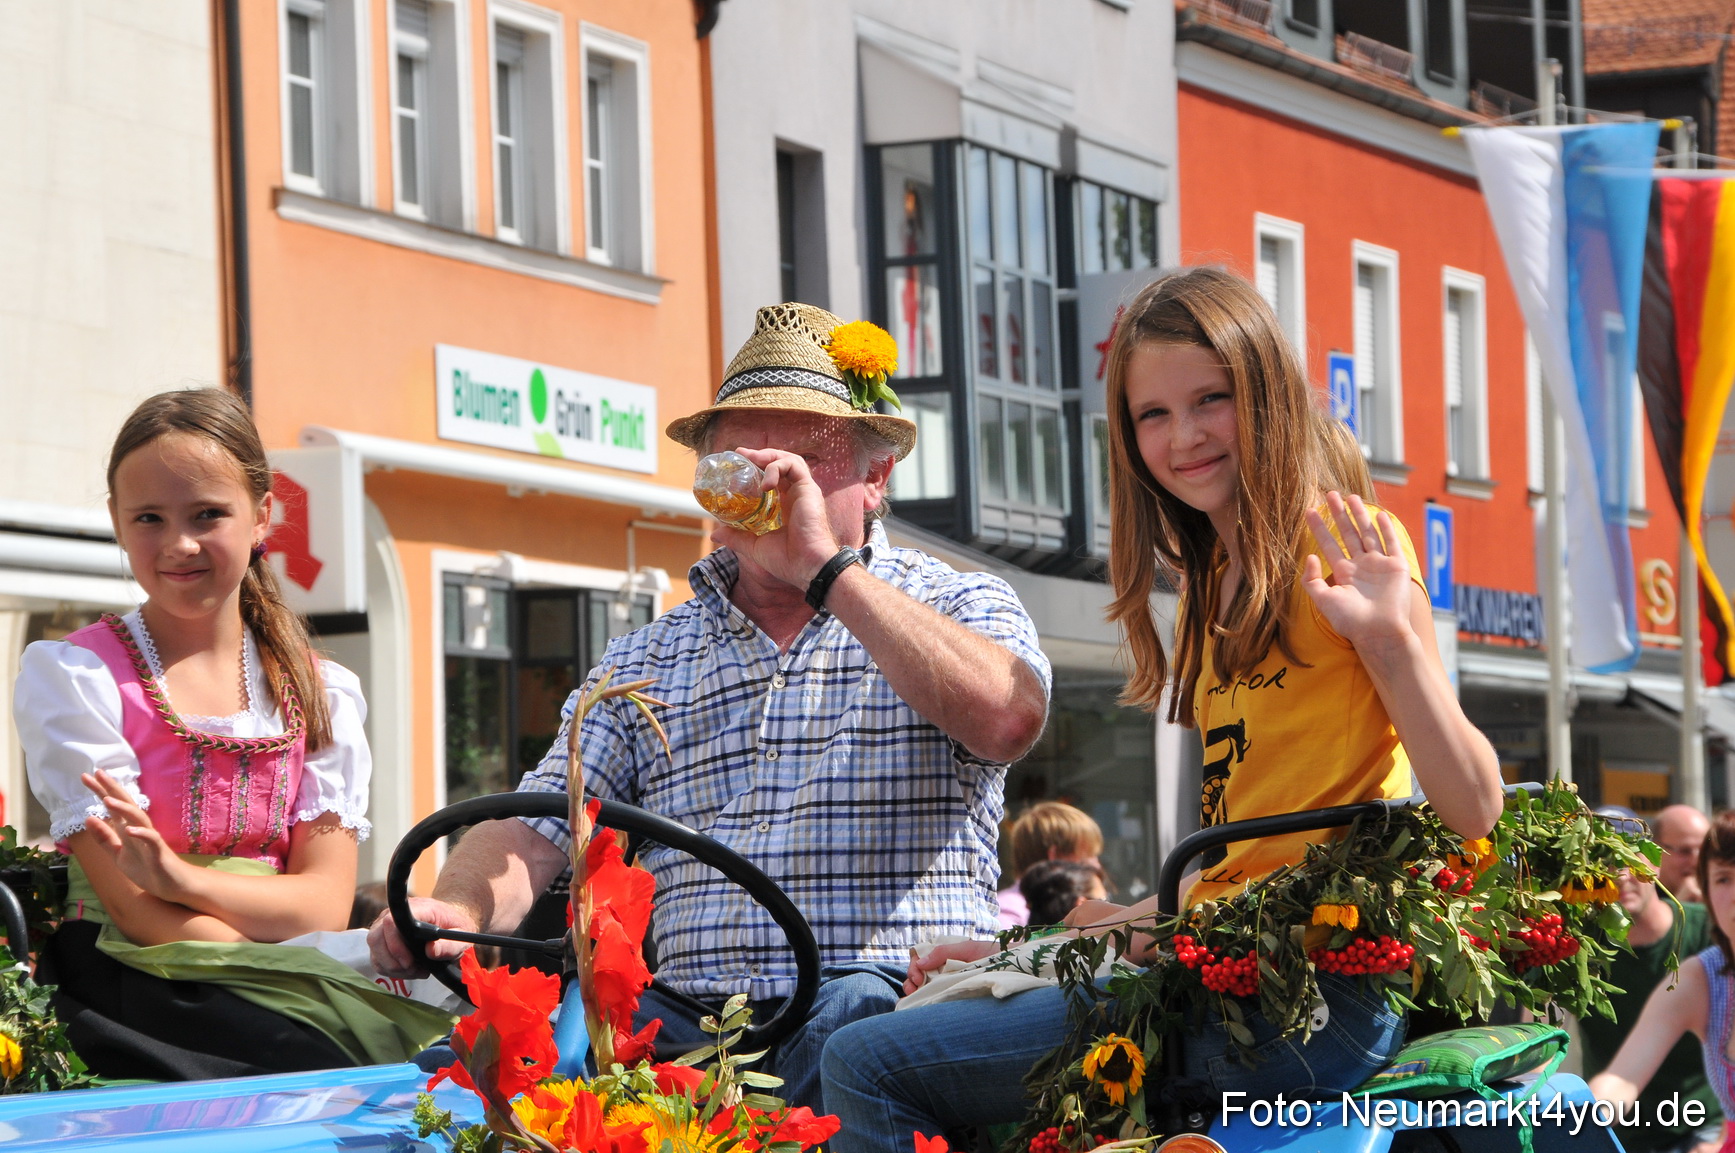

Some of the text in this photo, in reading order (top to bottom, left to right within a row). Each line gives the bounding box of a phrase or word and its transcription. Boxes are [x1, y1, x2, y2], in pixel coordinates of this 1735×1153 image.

[453, 369, 645, 451] Blumen Grün Punkt
[1430, 519, 1448, 598] P
